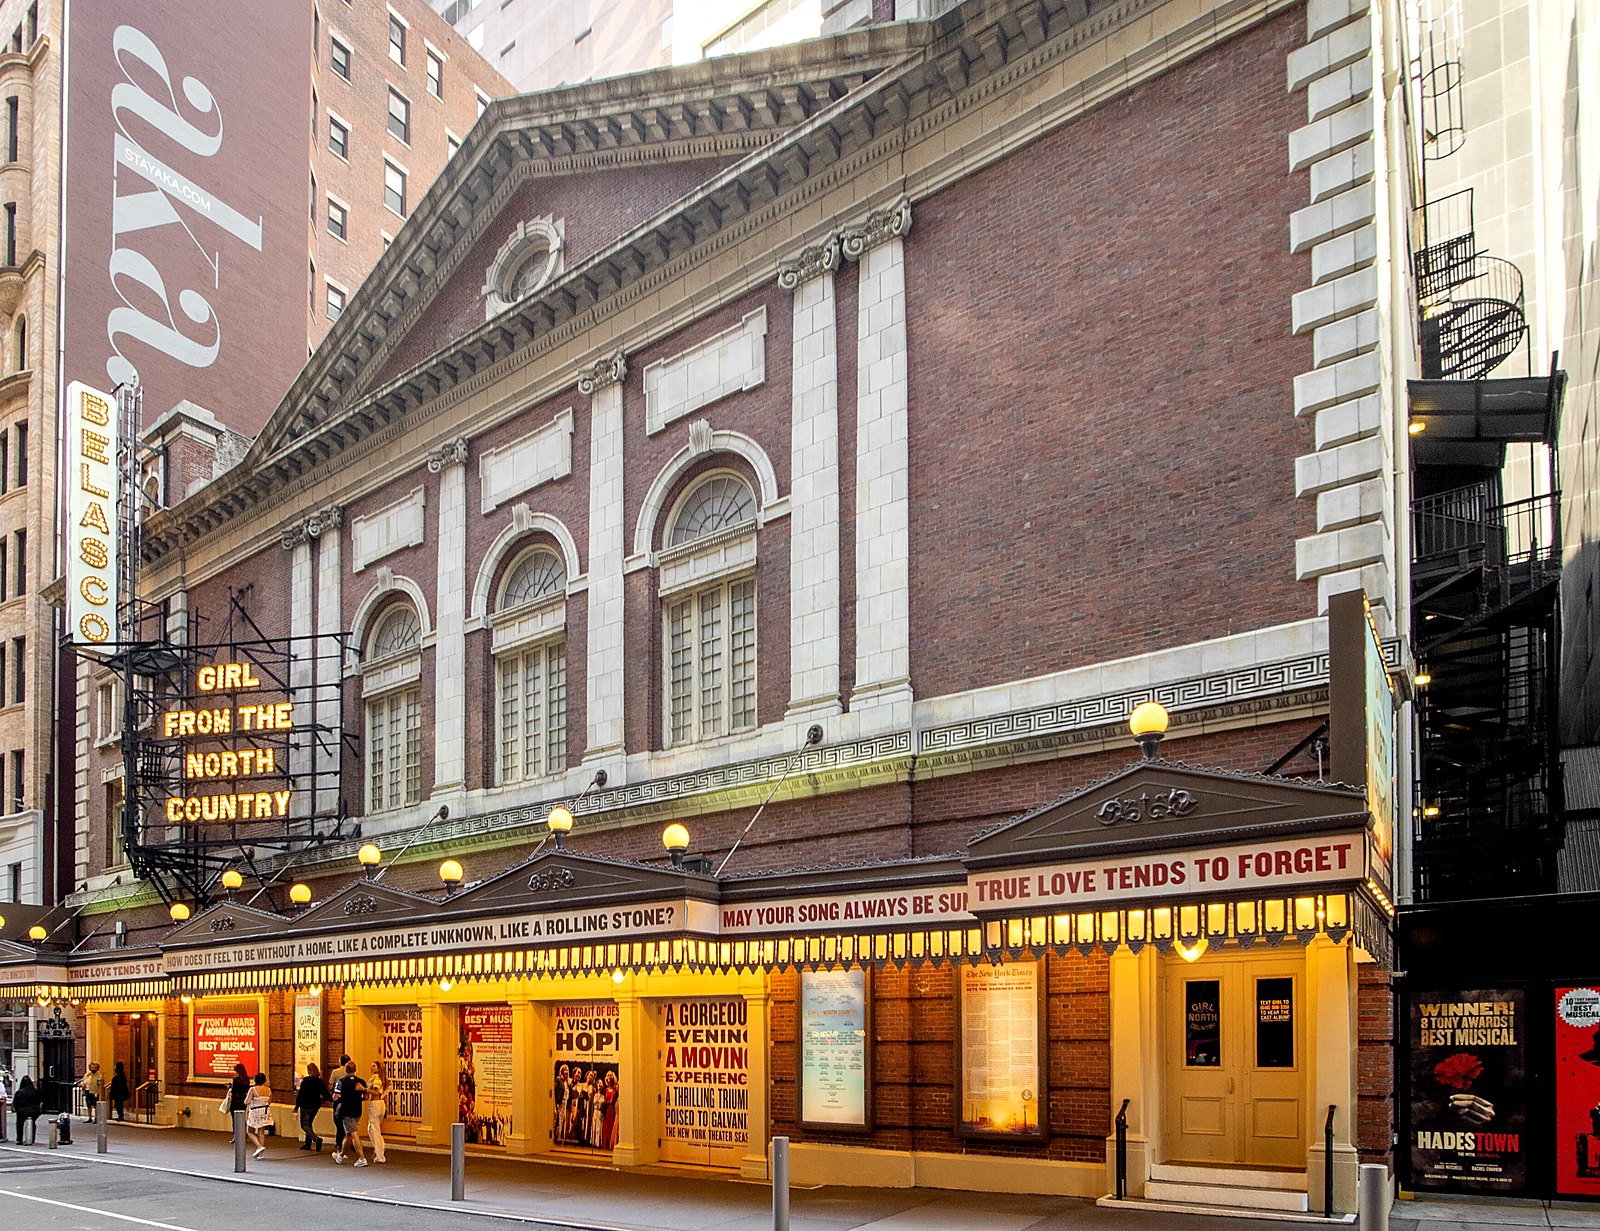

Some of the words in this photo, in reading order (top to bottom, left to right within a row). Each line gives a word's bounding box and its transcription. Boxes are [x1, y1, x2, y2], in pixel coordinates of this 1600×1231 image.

[124, 148, 212, 211] STAYAKA.COM
[80, 391, 110, 643] BELASCO
[198, 663, 260, 691] GIRL
[164, 707, 231, 737] FROM
[238, 702, 293, 731] THE
[186, 747, 275, 778] NORTH
[166, 790, 291, 822] COUNTRY
[976, 876, 1030, 902] TRUE
[1037, 870, 1096, 897] LOVE
[1103, 861, 1186, 891] TENDS
[1194, 856, 1230, 883] TO
[1237, 843, 1352, 879] FORGET
[723, 909, 752, 928] MAY
[756, 905, 795, 926] YOUR
[798, 902, 840, 923] SONG
[843, 896, 908, 920] ALWAYS
[912, 894, 934, 915] BE
[166, 954, 183, 967] HOW
[184, 953, 202, 966] DOES
[204, 952, 212, 965] IT
[213, 951, 231, 964] FEEL
[232, 950, 243, 963] TO
[245, 949, 255, 961] BE
[257, 944, 296, 960] WITHOUT
[297, 944, 304, 956] A
[306, 941, 335, 956] HOME,
[337, 938, 359, 953] LIKE
[361, 938, 368, 951] A
[370, 931, 428, 950] COMPLETE
[431, 925, 497, 946] UNKNOWN,
[500, 922, 529, 940] LIKE
[533, 921, 542, 936] A
[546, 914, 608, 935] ROLLING
[612, 906, 675, 928] STONE?
[70, 969, 89, 979] TRUE
[90, 967, 112, 978] LOVE
[113, 965, 141, 976] TENDS
[142, 963, 154, 974] TO
[966, 970, 978, 978] The
[979, 969, 993, 977] New
[994, 969, 1010, 978] York
[1012, 968, 1033, 976] Times
[556, 1007, 560, 1017] A
[561, 1007, 594, 1017] PORTRAIT
[596, 1006, 605, 1016] OF
[680, 1001, 748, 1026] GORGEOU
[1191, 1002, 1214, 1012] GIRL
[1419, 1001, 1515, 1017] WINNER!
[300, 1015, 315, 1026] GIRL
[465, 1015, 487, 1024] BEST
[556, 1019, 564, 1030] A
[567, 1018, 611, 1030] VISION
[1188, 1013, 1217, 1021] NORTH
[1421, 1017, 1429, 1028] 8
[1430, 1016, 1460, 1028] TONY
[1461, 1016, 1507, 1028] AWARDS
[197, 1018, 206, 1036] 7
[206, 1018, 225, 1027] TONY
[227, 1018, 255, 1027] AWARD
[205, 1027, 256, 1036] NOMINATIONS
[297, 1029, 318, 1040] NORTH
[384, 1022, 405, 1033] THE
[198, 1041, 217, 1051] BEST
[220, 1041, 255, 1051] MUSICAL
[1421, 1029, 1452, 1046] BEST
[1454, 1029, 1517, 1046] MUSICAL
[383, 1036, 393, 1059] IS
[396, 1036, 422, 1059] SUPE
[666, 1046, 677, 1067] A
[384, 1061, 396, 1078] THE
[666, 1071, 747, 1085] EXPERIENC
[392, 1080, 404, 1090] THE
[666, 1086, 670, 1106] A
[673, 1086, 714, 1108] THRILLING
[718, 1088, 748, 1110] TRIUM
[666, 1108, 694, 1126] POISED
[698, 1110, 708, 1127] TO
[712, 1110, 748, 1129] GALVANI
[666, 1127, 675, 1137] THE
[677, 1127, 689, 1138] NEW
[691, 1129, 706, 1139] YORK
[708, 1129, 732, 1141] THEATER
[1417, 1131, 1519, 1152] HADESTOWN
